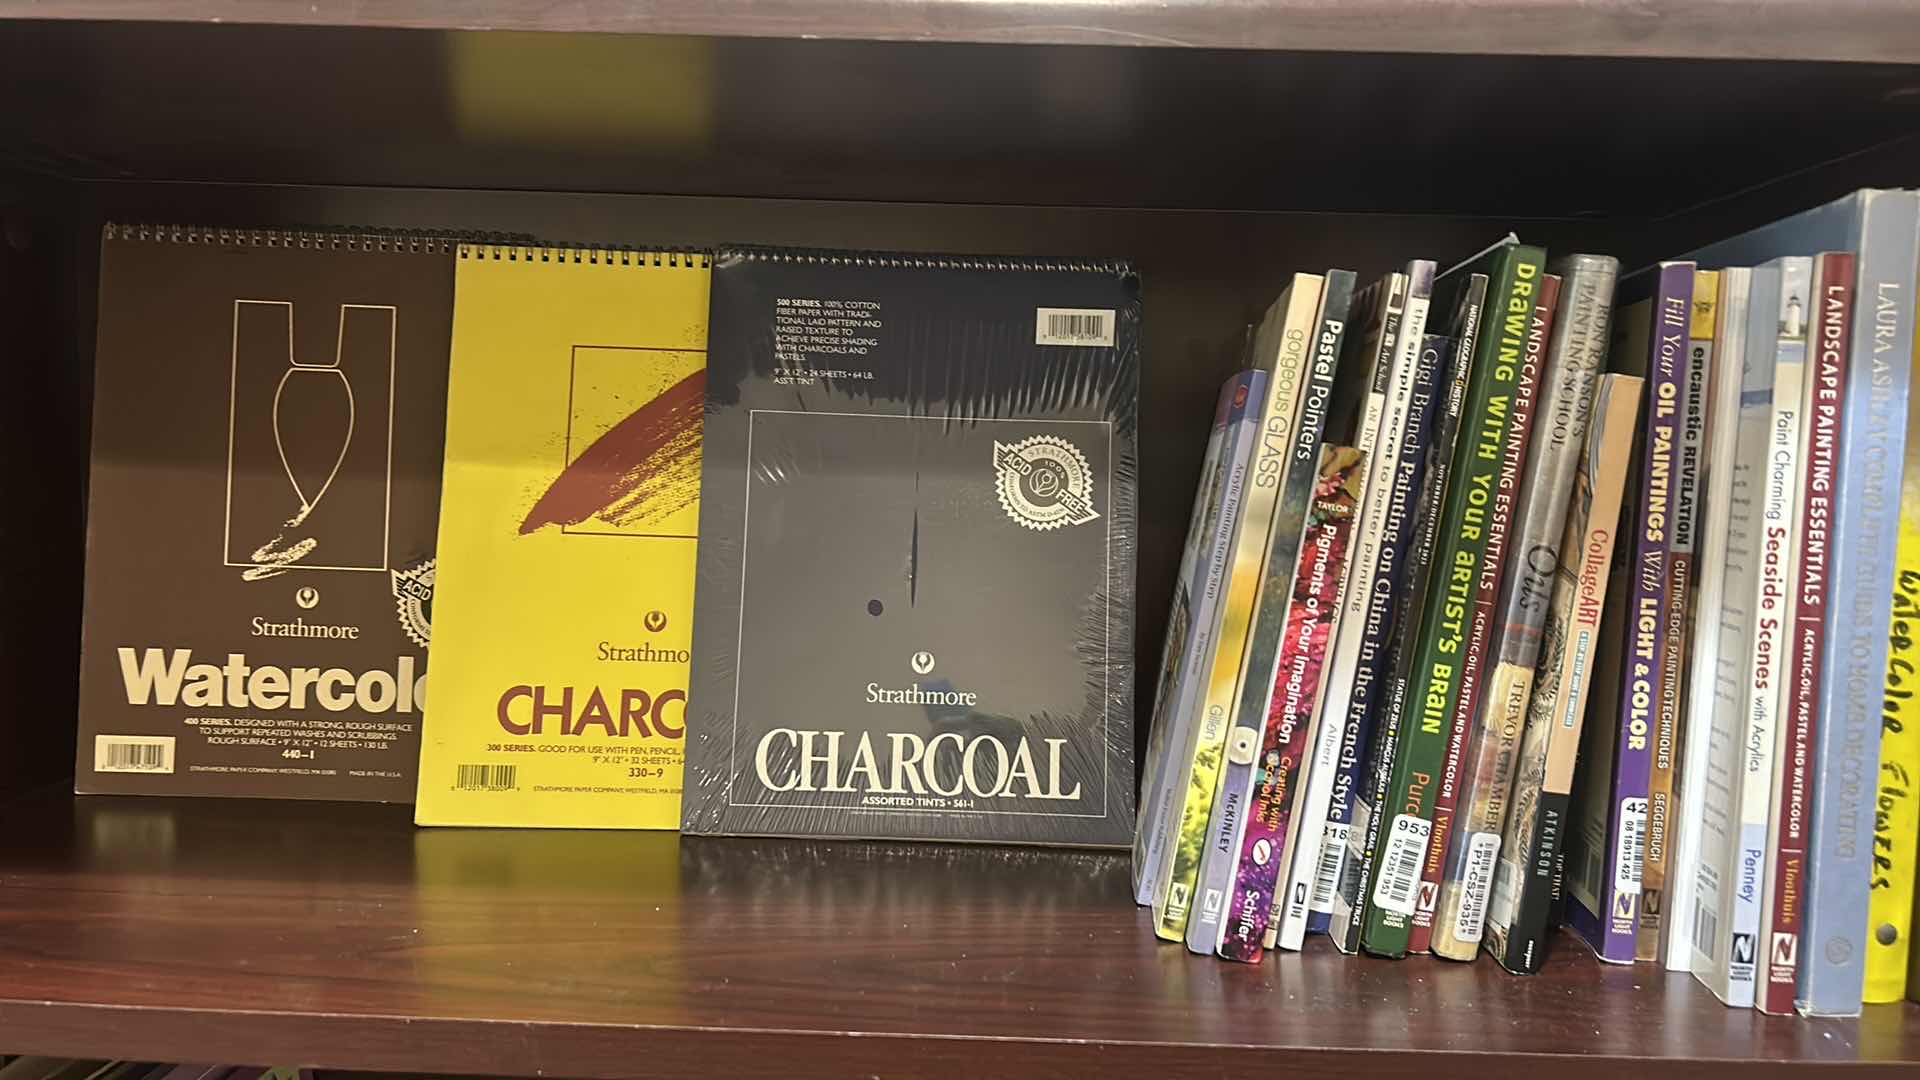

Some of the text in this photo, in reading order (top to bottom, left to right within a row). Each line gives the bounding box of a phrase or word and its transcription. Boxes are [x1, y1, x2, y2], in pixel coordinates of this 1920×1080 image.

[776, 307, 872, 318] FIBER PAPER WITH TRADI-
[776, 316, 882, 328] TIONAL LAID AND
[804, 326, 853, 336] TEXTURE TO
[844, 301, 881, 310] COTTON
[1873, 281, 1899, 354] LAURA
[841, 337, 878, 346] SHADING
[848, 346, 868, 355] AND
[1374, 316, 1397, 391] The Art School
[1449, 304, 1477, 416] NATIONAL GEOGRAPHIC HISTORY
[1550, 284, 1595, 450] PAINTING SCHOOL
[1572, 304, 1609, 439] RON RANSON'S
[818, 370, 847, 379] SHEETS
[1297, 319, 1342, 459] Pastel Pointers
[1866, 358, 1893, 441] ASHLEY
[1255, 328, 1304, 488] gorgeous GLASS
[1478, 395, 1507, 458] WITH
[1002, 453, 1032, 476] ACID
[1351, 309, 1423, 611] the simple secret to better painting
[1499, 412, 1524, 488] PAINTING
[1676, 347, 1704, 544] encaustic REVELATION
[1804, 286, 1843, 603] LANDSCAPE PAINTING ESSENTIALS
[1055, 488, 1088, 514] FREE
[1205, 463, 1244, 598] Acrylic Painting Step by Step
[1317, 500, 1348, 512] TAYLOR
[1423, 464, 1445, 546] NOVEMBER/DECEMBER
[1628, 297, 1684, 749] Fill Your OIL PAINTINGS With LIGHT & COLOR
[1761, 410, 1793, 610] Paint Charming Seaside
[1479, 494, 1509, 589] ESSENTIALS
[402, 580, 432, 601] ACID
[1326, 348, 1438, 819] Gigi Branch Painting on China in the French Style
[1518, 544, 1557, 613] Oils
[1579, 528, 1607, 625] CollageART
[251, 617, 360, 639] Strathmore
[597, 641, 690, 664] Strathmo
[1278, 524, 1335, 743] Pigments of Your Imagination
[117, 647, 428, 713] Watercol
[866, 682, 977, 706] Strathmore
[1658, 560, 1685, 768] CUTTING-EDGE PAINTING TECHNIQUES
[1744, 618, 1777, 771] Scenes with Acrylics
[199, 727, 211, 735] TO
[211, 727, 250, 736] SUPPORT
[252, 728, 292, 737] REPEATED
[327, 730, 347, 739] AND
[234, 719, 299, 728] DESIGNED WITH
[497, 685, 687, 739] CHARC
[1442, 611, 1485, 797] ACRYLIC, OIL, PASTEL AND WATERCOLOR
[1789, 629, 1815, 837] ACRYLIC, OIL, PASTEL AND WATERCOLOR
[208, 736, 240, 745] ROUGH
[503, 744, 629, 755] SERIES. GOOD FOR USE WITH
[641, 757, 671, 765] SHEETS
[754, 727, 1081, 800] CHARCOAL
[1320, 723, 1337, 766] Albert
[1483, 680, 1525, 832] TREVOR CHAMBER
[861, 796, 914, 806] ASSORTED
[917, 797, 945, 807] TINTS
[1218, 793, 1238, 852] McKINLEY
[1254, 798, 1268, 824] Inks
[1266, 755, 1292, 832] Creating with
[1405, 771, 1429, 817] Purc
[1398, 820, 1429, 836] 953
[1427, 815, 1447, 873] Vloothuis
[1536, 810, 1557, 875] ATKINSON
[1620, 820, 1634, 880] 08 18913 425
[1649, 793, 1665, 860] SEGGEBRUCH
[1551, 854, 1563, 899] TOP THAT!
[1738, 849, 1760, 902] Penney
[1782, 858, 1798, 922] Vloothuis
[1237, 890, 1259, 941] Schiffer
